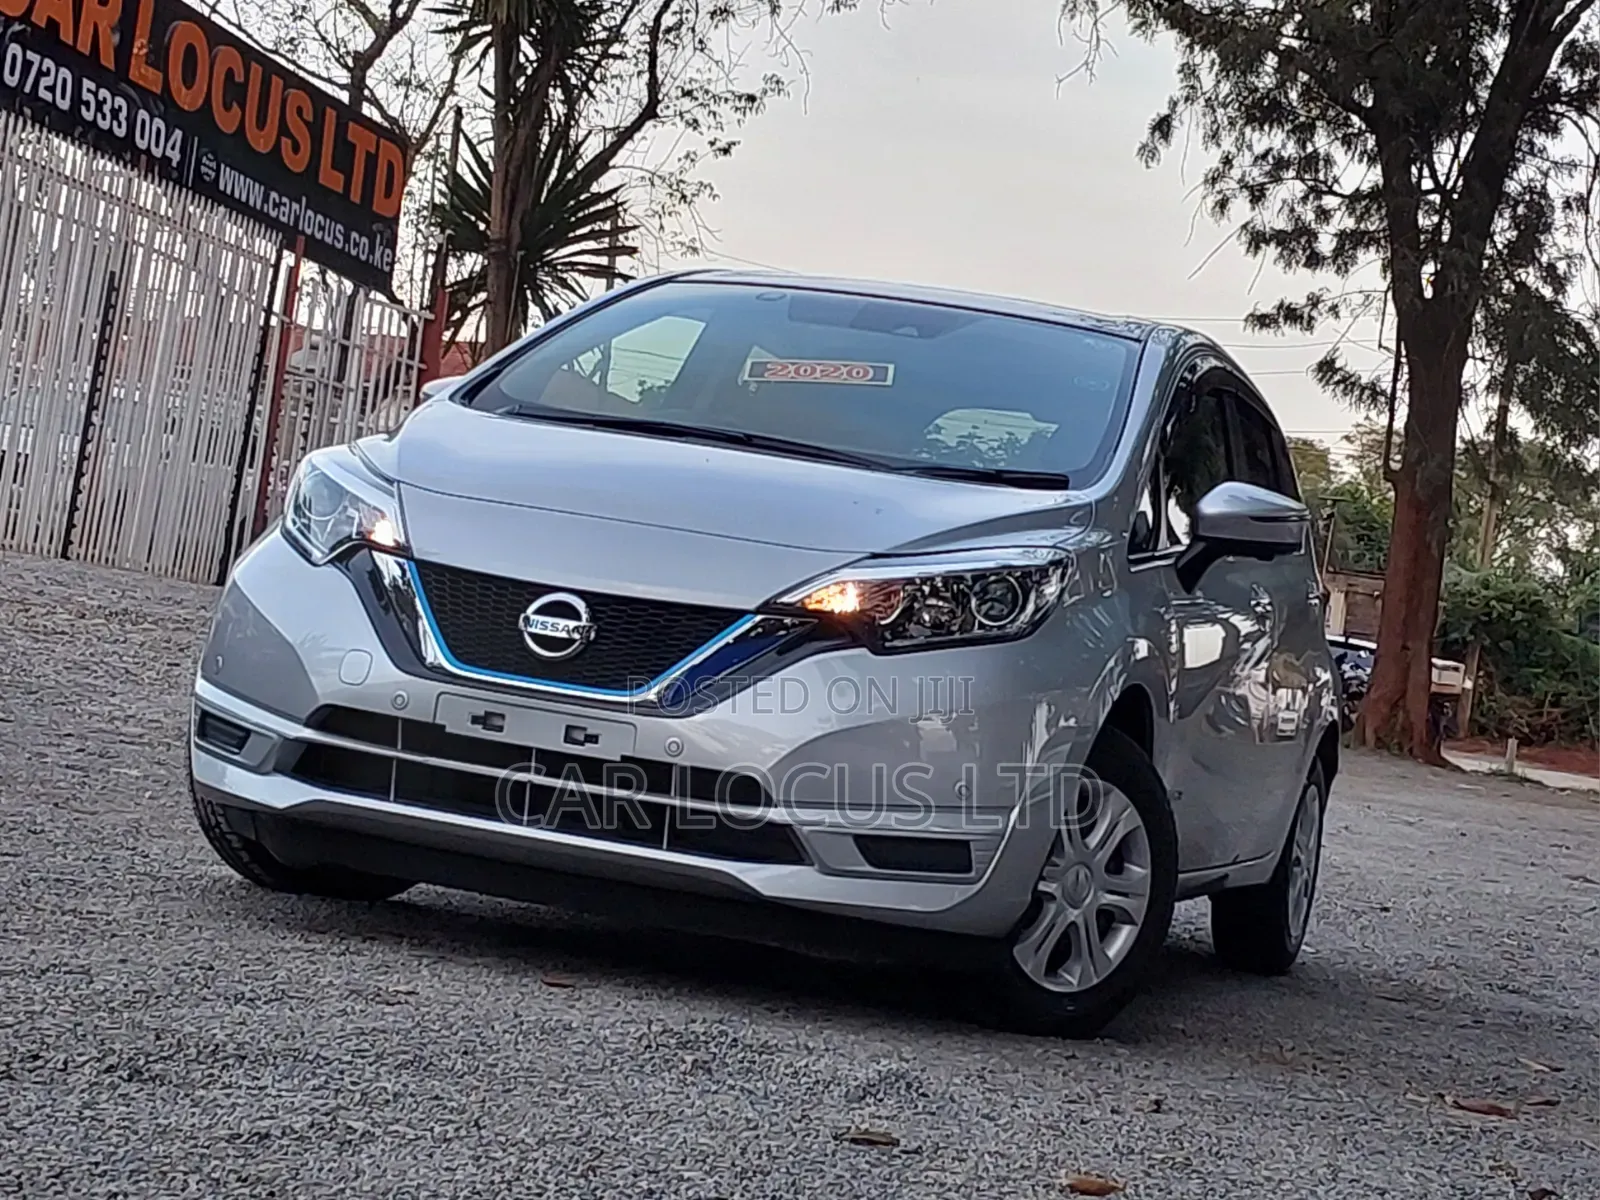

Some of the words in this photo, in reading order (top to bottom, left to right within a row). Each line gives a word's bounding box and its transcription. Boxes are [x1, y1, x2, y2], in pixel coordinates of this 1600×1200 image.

[0, 0, 122, 71] AR
[128, 0, 315, 173] LOCUS
[317, 106, 404, 219] LTD
[3, 43, 73, 111] 0720
[80, 76, 128, 138] 533
[134, 110, 183, 169] 004
[218, 161, 393, 273] www.carlocus.co.ke
[764, 363, 874, 381] 2020
